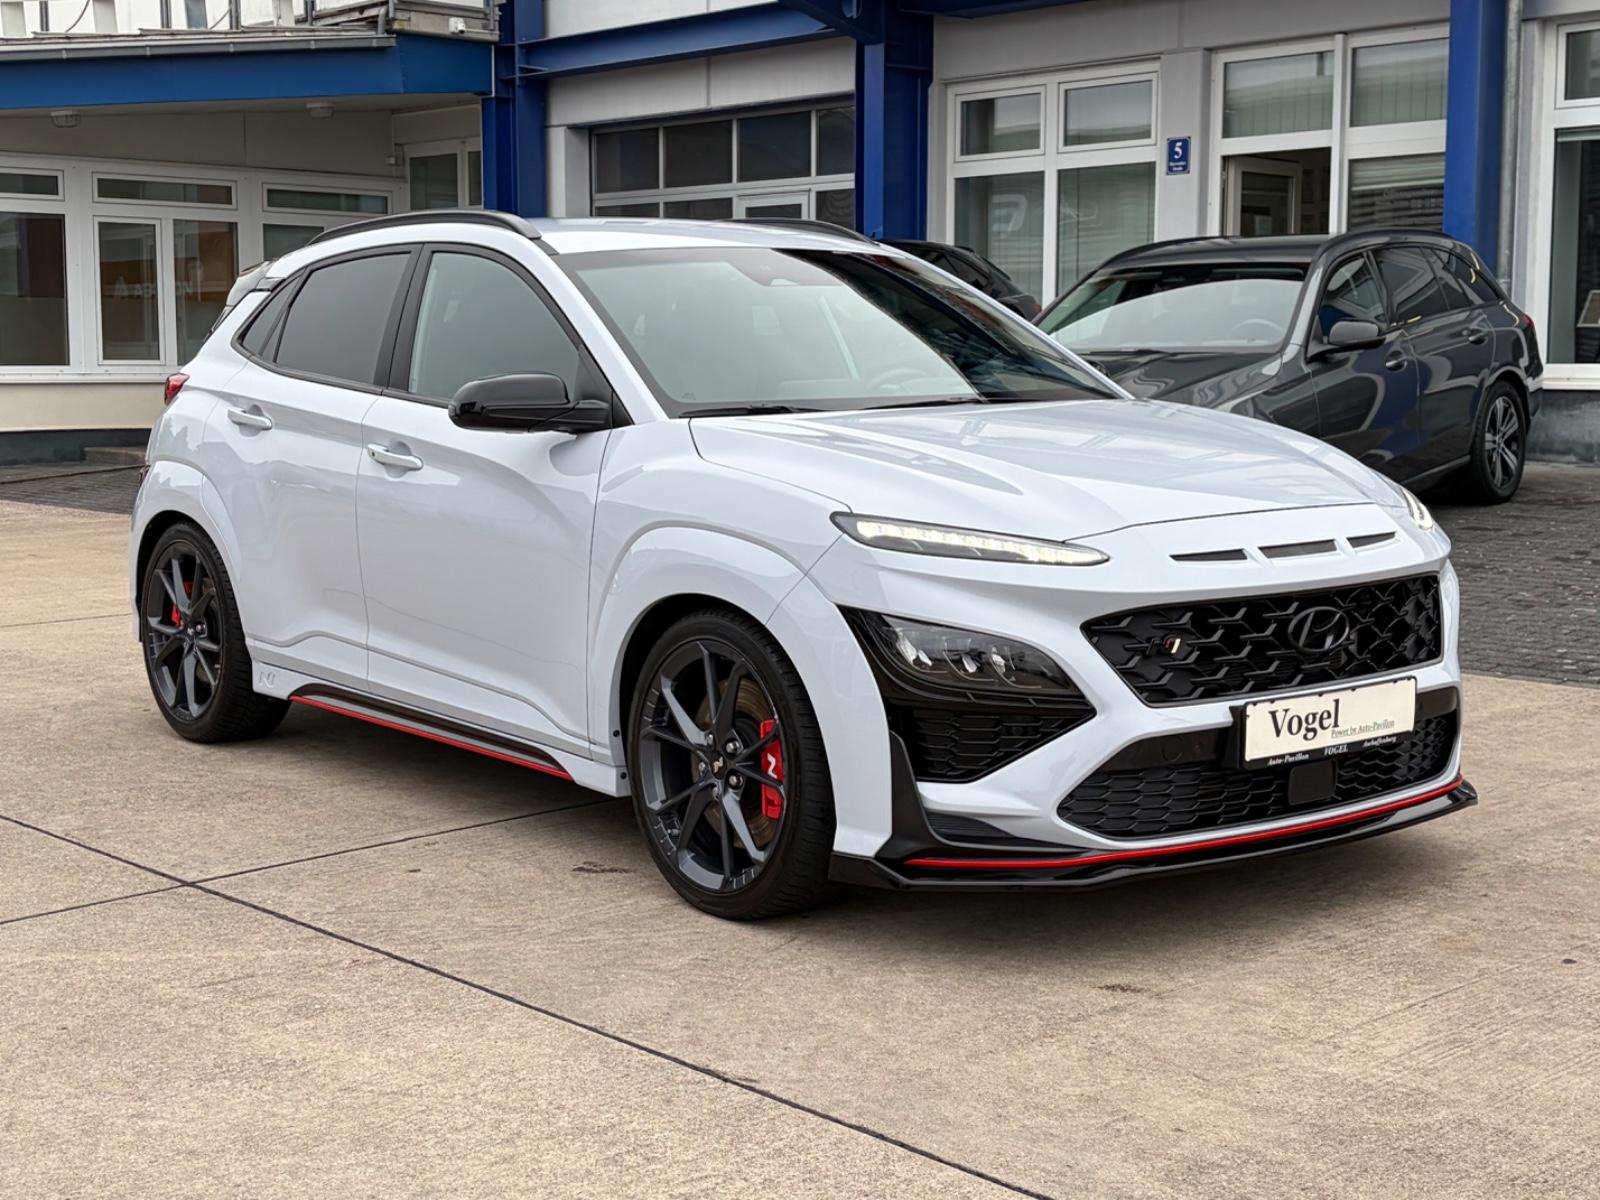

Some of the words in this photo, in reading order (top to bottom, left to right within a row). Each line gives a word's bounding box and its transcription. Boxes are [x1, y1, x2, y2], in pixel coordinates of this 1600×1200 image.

[1174, 141, 1183, 159] 5
[1268, 698, 1340, 742] Vogel
[1331, 728, 1349, 739] Power
[1324, 744, 1349, 756] VOGEL
